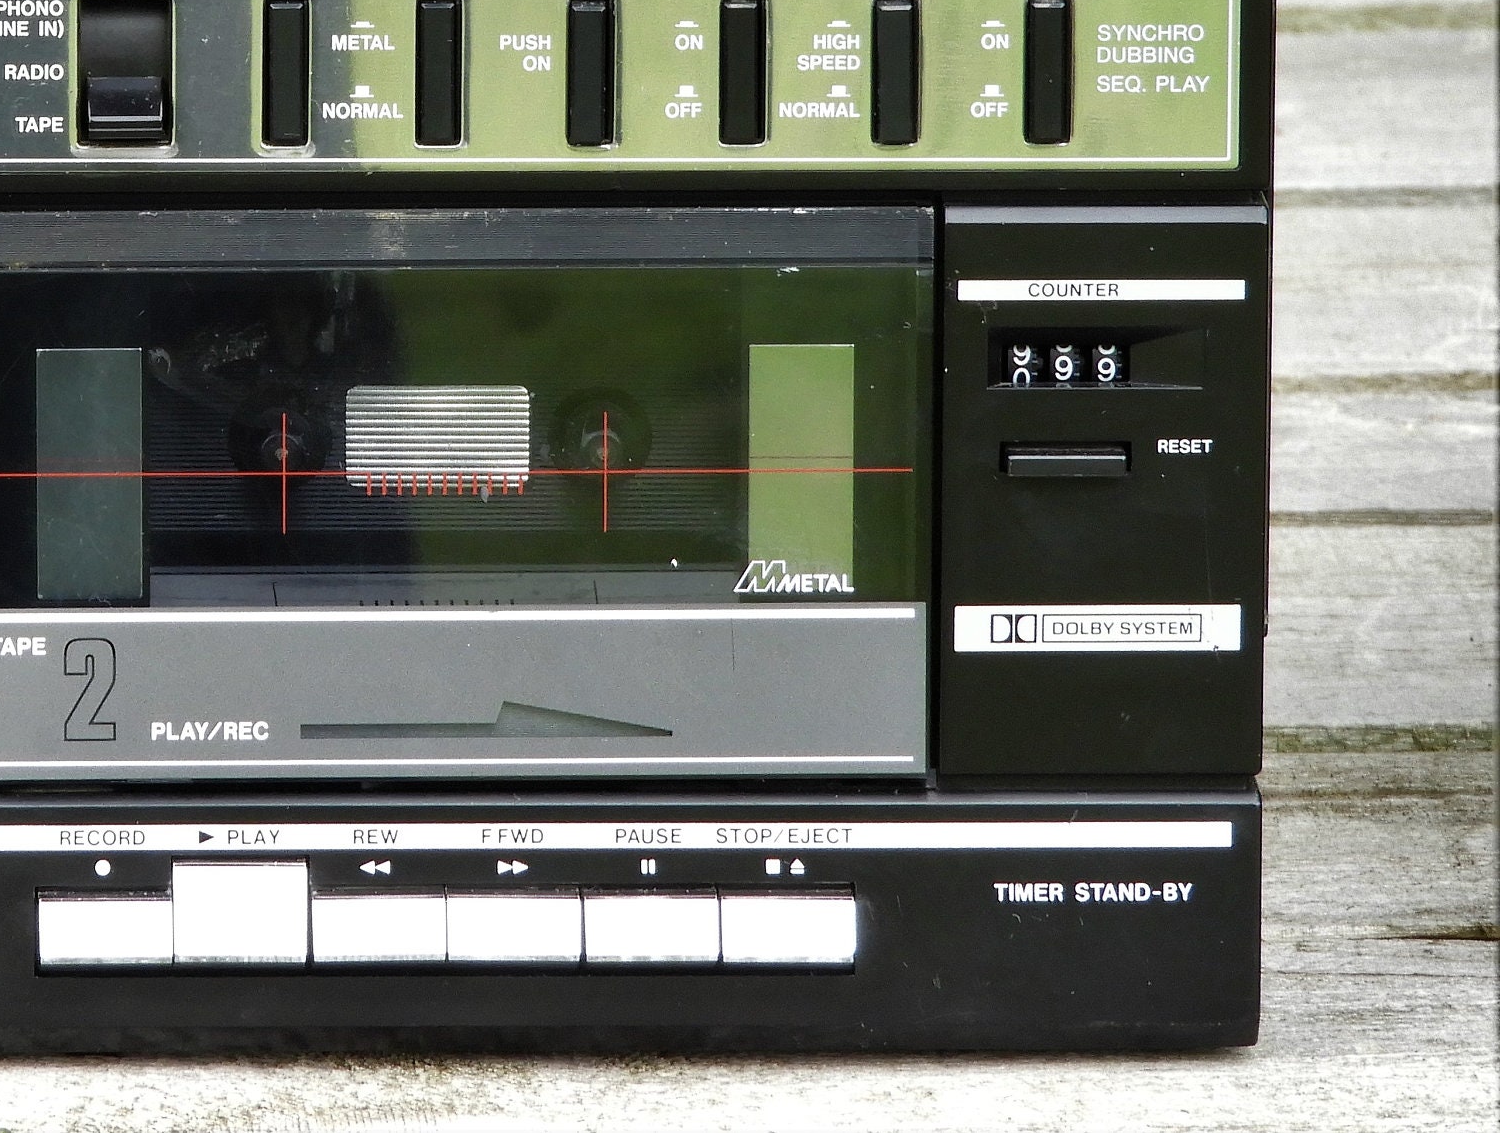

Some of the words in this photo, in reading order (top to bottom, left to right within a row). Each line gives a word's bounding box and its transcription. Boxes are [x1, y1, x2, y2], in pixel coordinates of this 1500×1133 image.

[39, 20, 64, 38] IN)
[1098, 25, 1204, 41] SYNCHRO
[332, 35, 395, 50] METAL
[500, 35, 550, 50] PUSH
[675, 34, 703, 50] ON
[814, 34, 859, 50] HIGH
[981, 34, 1008, 49] ON
[797, 55, 860, 70] SPEED
[1097, 47, 1194, 63] DUBBING
[523, 55, 550, 71] ON
[5, 64, 64, 80] RADIO
[1097, 76, 1146, 93] SEQ.
[1156, 76, 1209, 92] PLAY
[323, 103, 404, 119] NORMAL
[665, 103, 702, 118] OFF
[779, 102, 860, 118] NORMAL
[971, 102, 1008, 117] OFF
[15, 117, 63, 132] TAPE
[1029, 284, 1118, 297] COUNTER
[1158, 439, 1213, 453] RESET
[1053, 622, 1113, 634] DOLBY
[1121, 622, 1192, 634] SYSTEM
[64, 638, 116, 741] 2
[152, 721, 269, 740] PLAY/REC
[61, 830, 144, 845] RECORD
[228, 830, 279, 844] PLAY
[354, 830, 397, 843] REW
[616, 829, 681, 843] PAUSE
[717, 828, 852, 843] STOP/EJECT
[994, 883, 1063, 902] TIMER
[1075, 883, 1192, 902] STAND-BY
